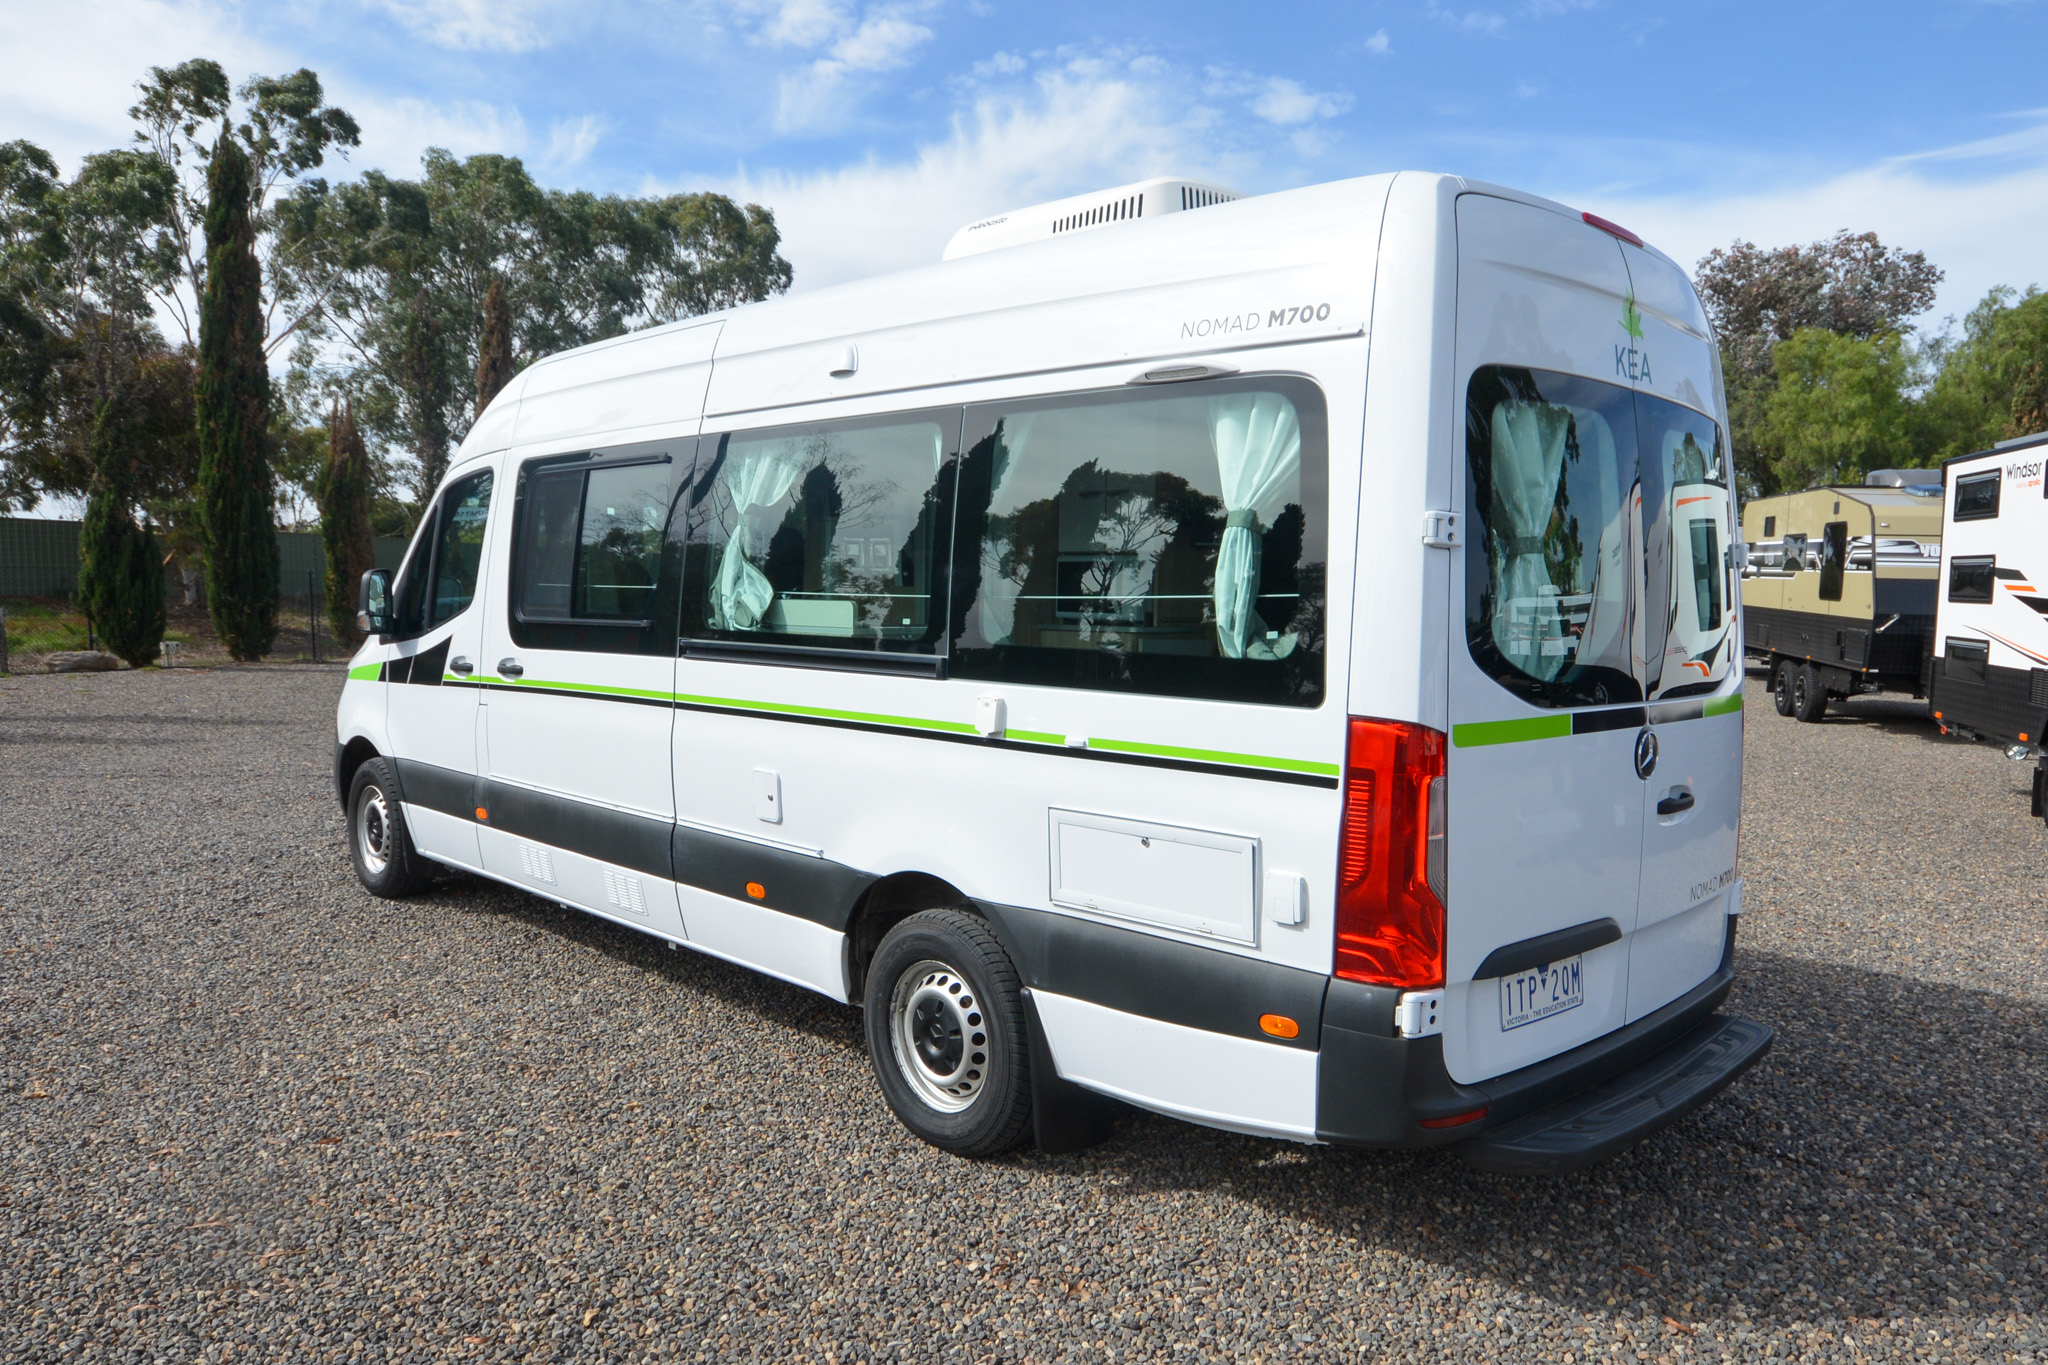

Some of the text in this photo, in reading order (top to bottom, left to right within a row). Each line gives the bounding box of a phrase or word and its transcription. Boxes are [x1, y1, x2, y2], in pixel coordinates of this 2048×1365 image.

[1181, 303, 1331, 339] NOMAD M700
[1615, 344, 1652, 384] KEA
[2006, 461, 2042, 479] Windsor
[1690, 876, 1717, 901] NOMAD
[1506, 961, 1580, 1016] 1TP 2QM
[1507, 1014, 1529, 1026] VICTORIA
[1533, 1008, 1542, 1018] THE
[1543, 1000, 1566, 1014] EDUCATION
[1567, 996, 1579, 1006] STATE
